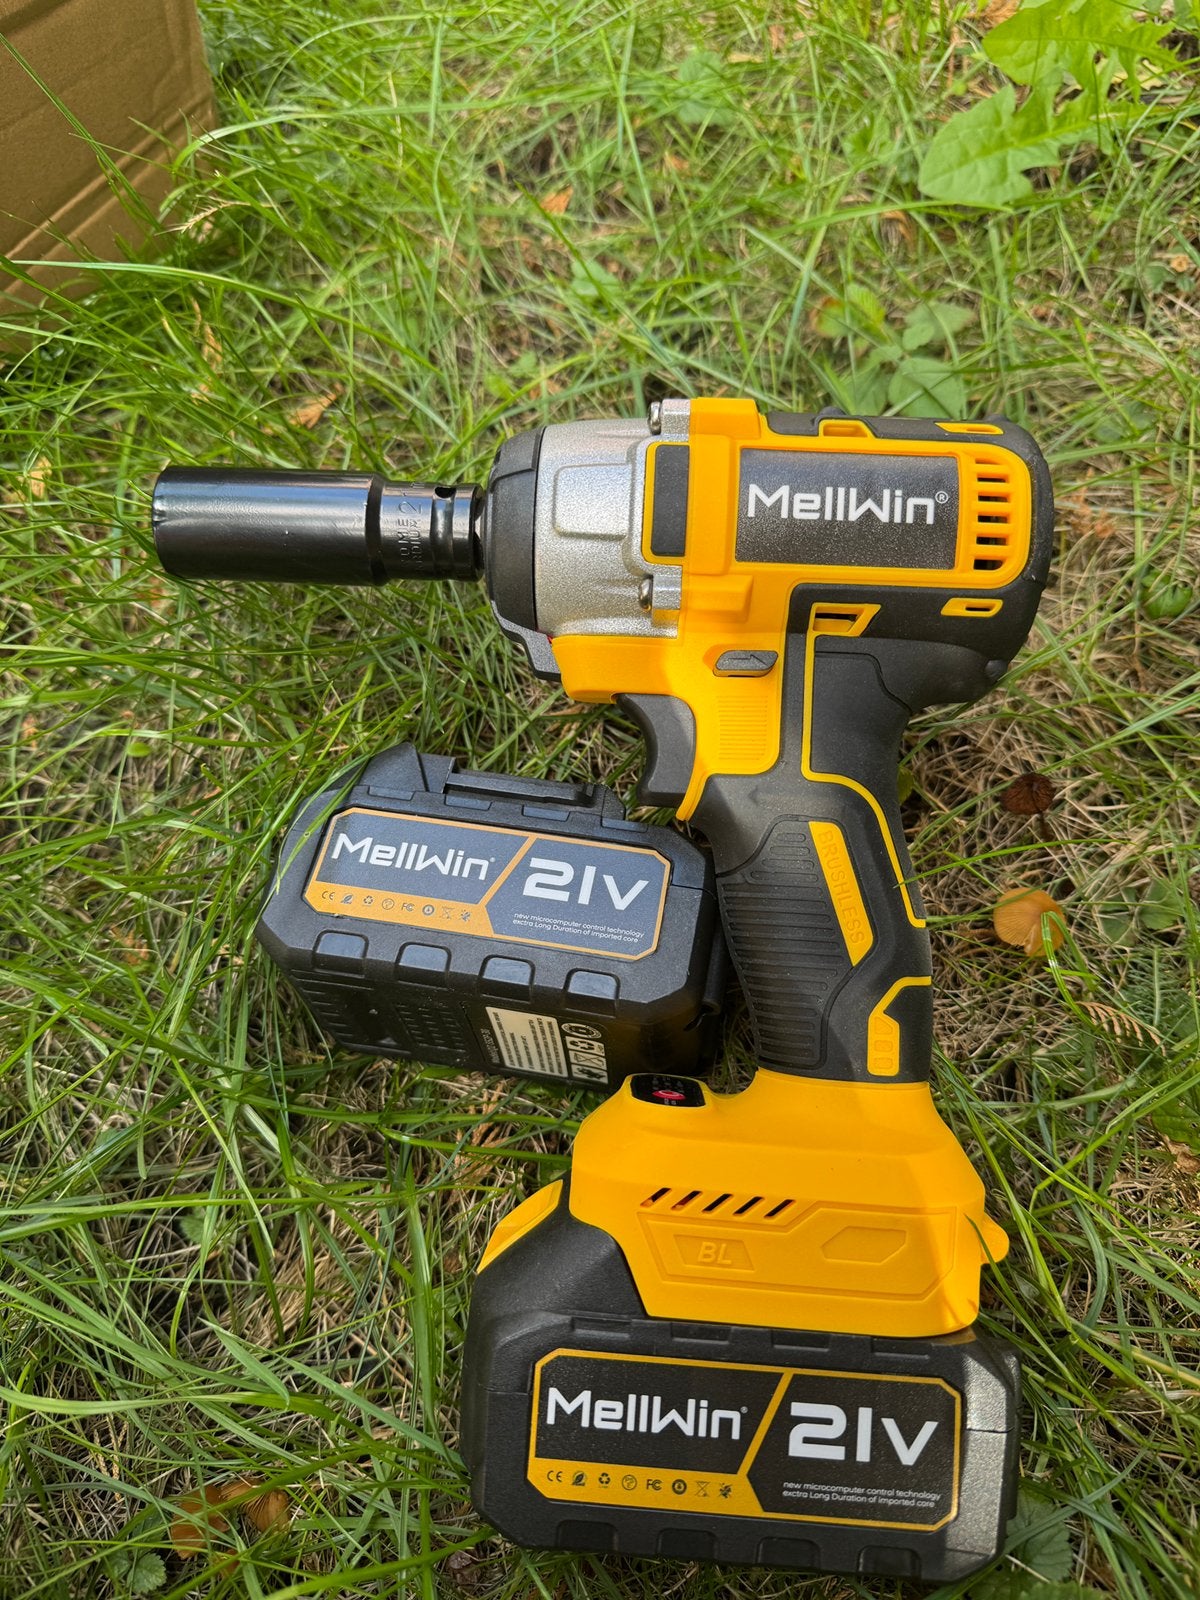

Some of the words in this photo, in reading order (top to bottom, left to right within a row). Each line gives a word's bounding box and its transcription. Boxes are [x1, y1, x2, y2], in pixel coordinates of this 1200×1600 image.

[818, 830, 865, 944] BRUSHLESS
[512, 919, 534, 927] exctra
[534, 921, 552, 931] Long
[552, 924, 582, 935] Duration
[622, 936, 639, 944] core
[530, 915, 581, 928] microcomputer
[582, 923, 606, 932] control
[606, 926, 645, 939] technology
[698, 1242, 732, 1265] BL
[782, 1490, 809, 1498] exctra
[809, 1491, 830, 1501] Long
[831, 1492, 867, 1503] Duration
[868, 1495, 877, 1503] of
[783, 1481, 801, 1489] new
[803, 1482, 865, 1494] microcomputer
[866, 1488, 895, 1497] control
[896, 1490, 941, 1501] technology
